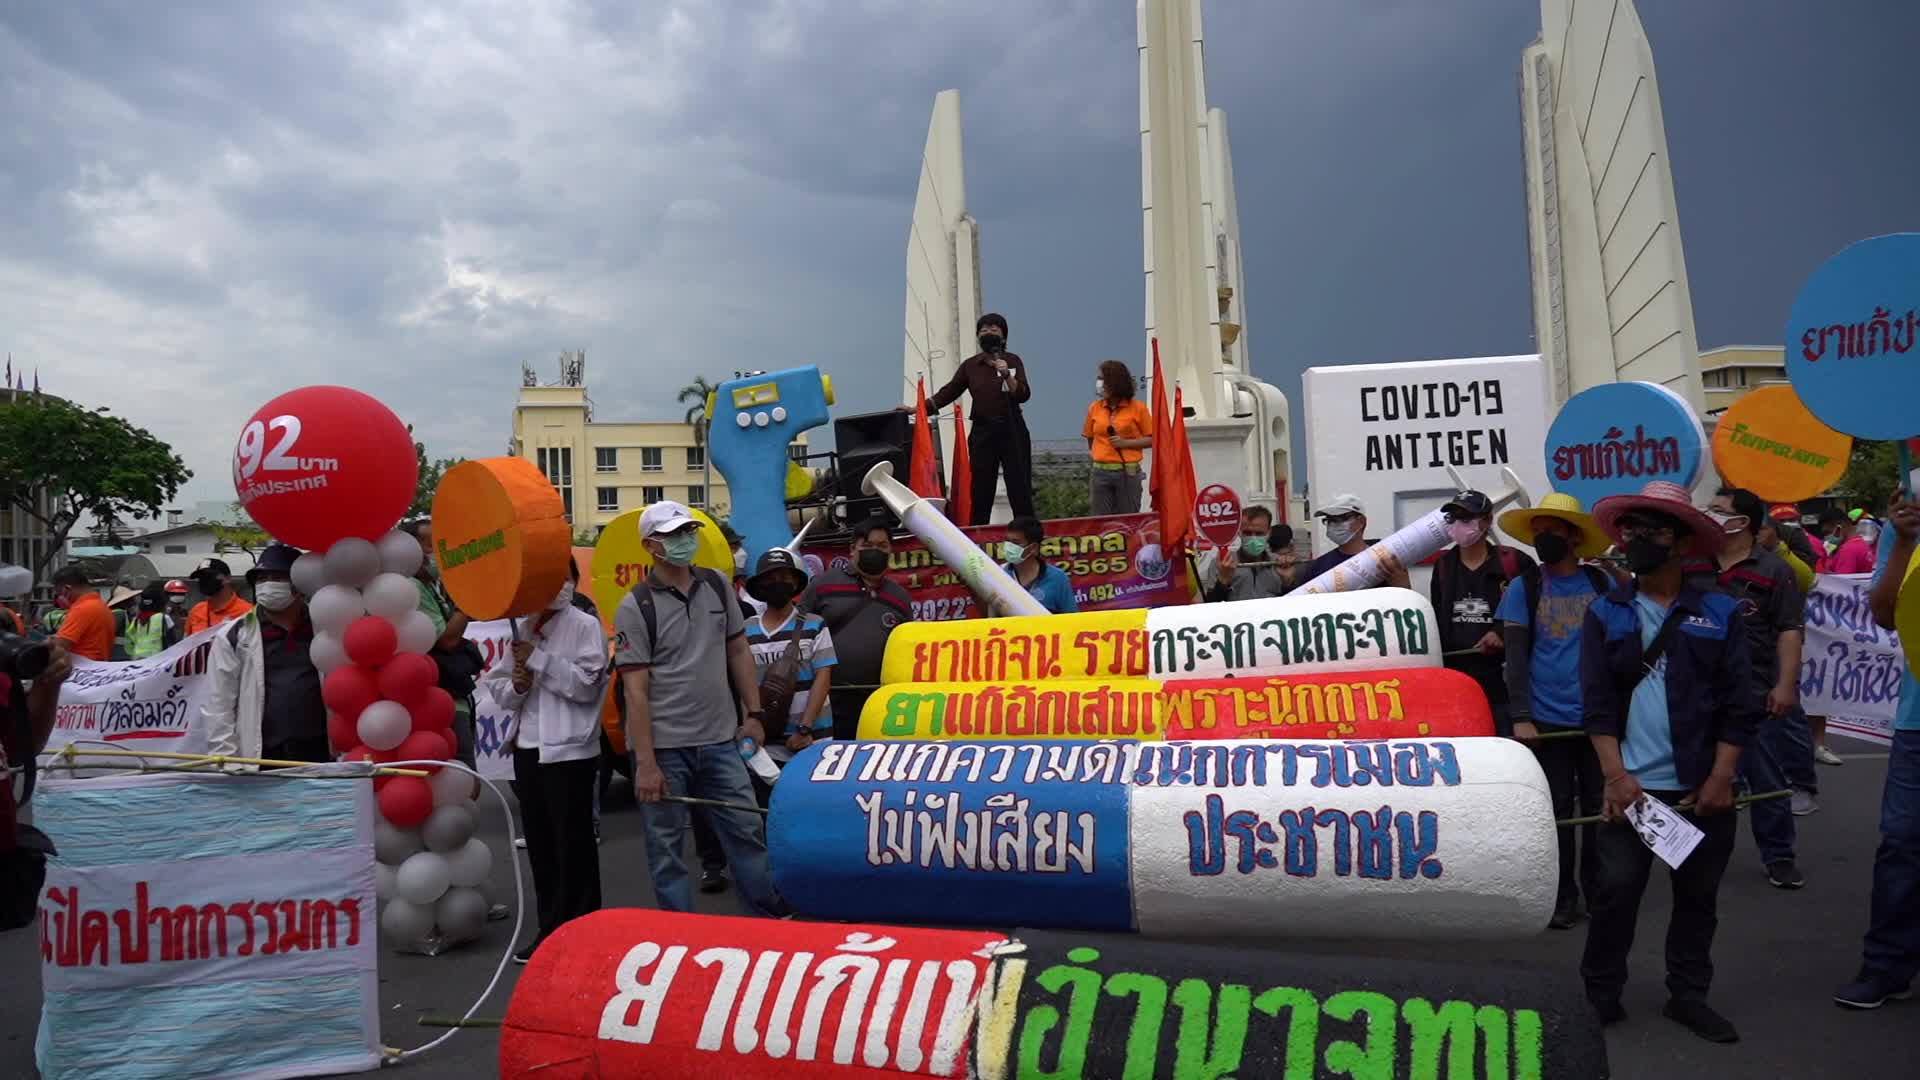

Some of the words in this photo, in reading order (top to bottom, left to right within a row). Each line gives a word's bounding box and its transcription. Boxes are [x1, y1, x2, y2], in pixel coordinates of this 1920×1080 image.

[1802, 306, 1920, 362] ยาแก้ป
[1361, 380, 1503, 421] COVID-19
[233, 414, 302, 484] 92
[1366, 428, 1508, 471] ANTIGEN
[1553, 424, 1681, 481] ยาแก้ปวด
[1199, 501, 1234, 517] 492
[615, 563, 648, 588] ยา
[912, 627, 1062, 682] ยาแก้จน
[856, 790, 1096, 873] ไม่ฟังเสียง
[1184, 793, 1443, 880] ประชาชน
